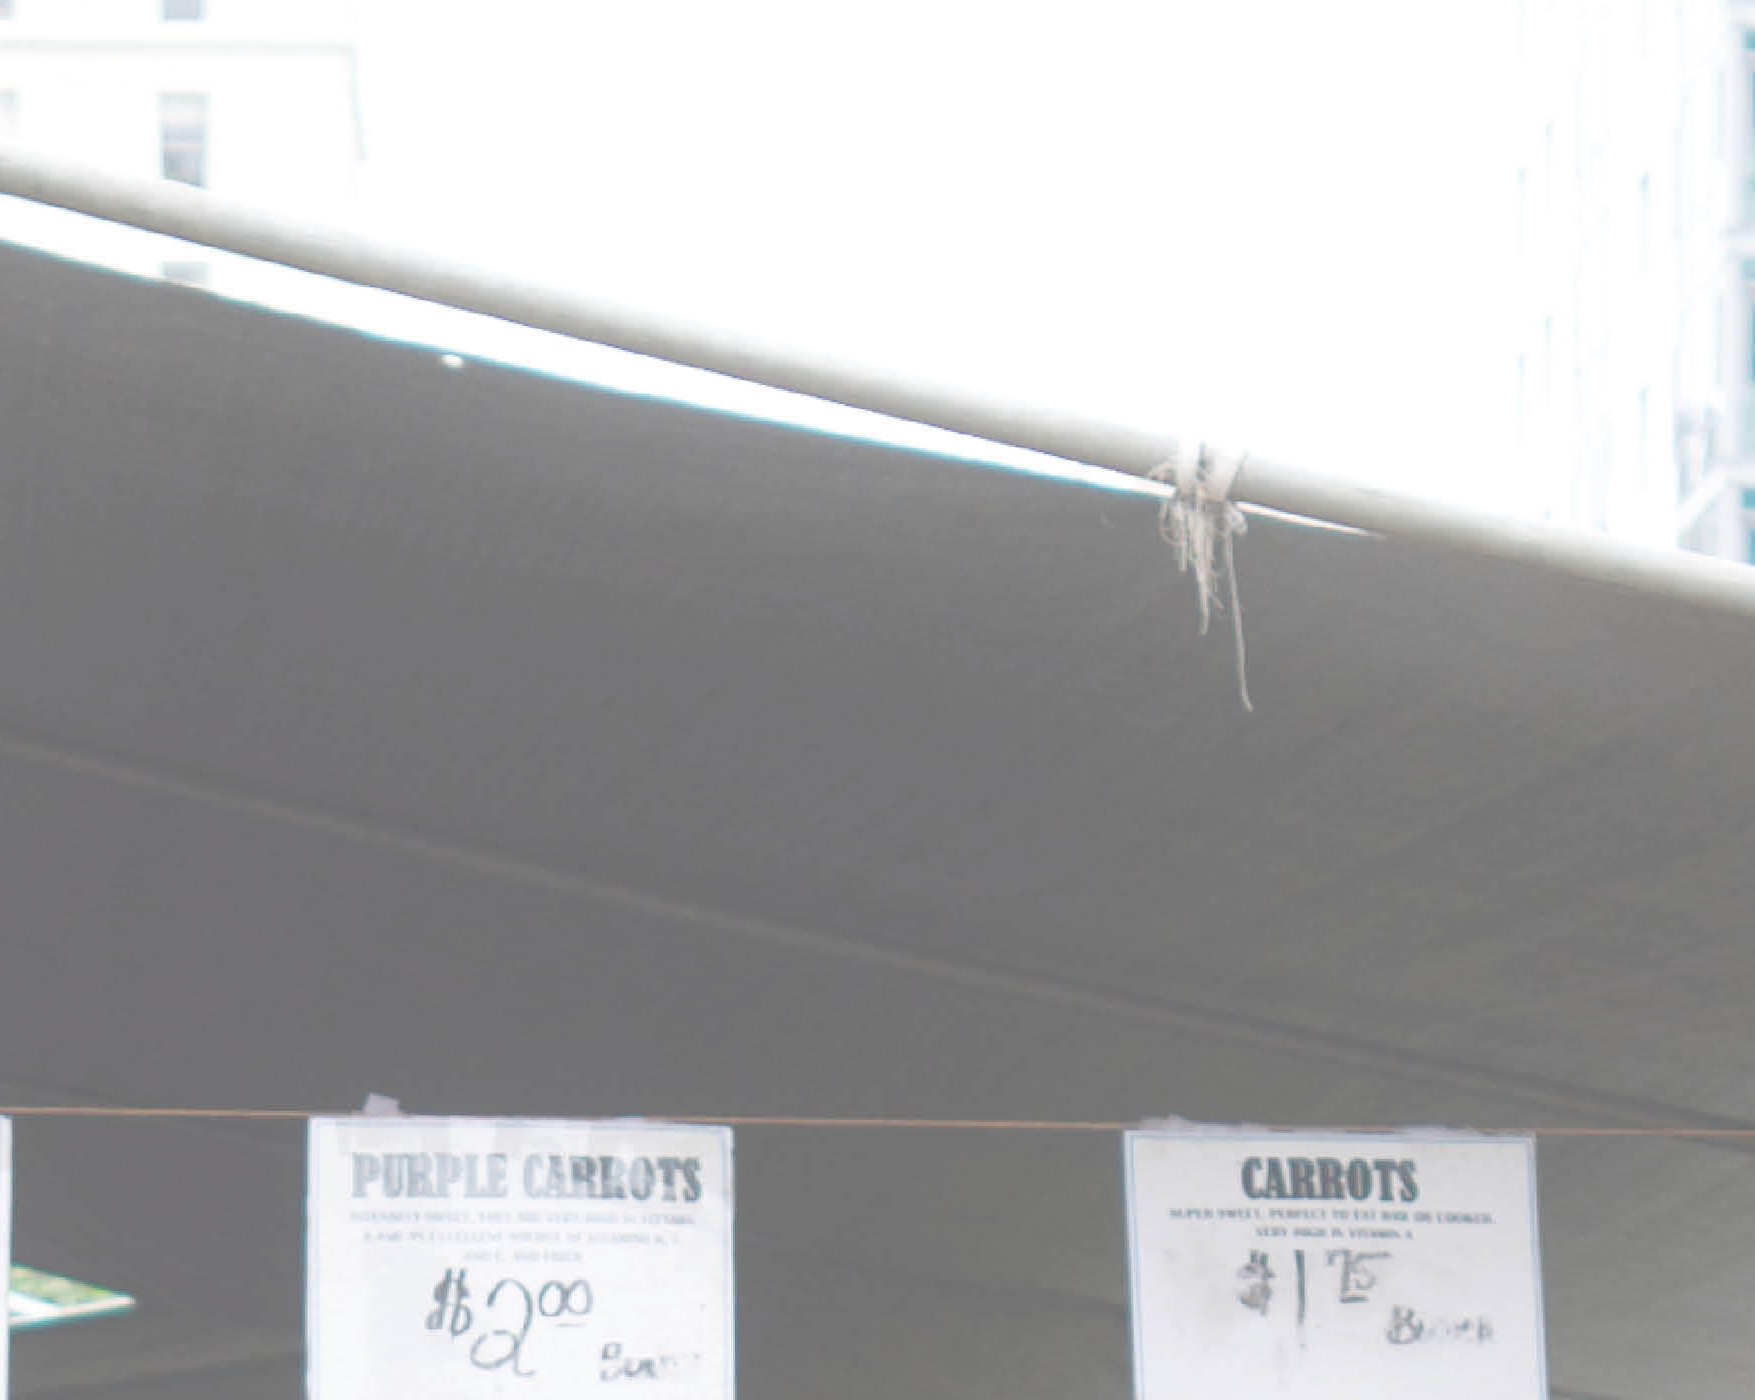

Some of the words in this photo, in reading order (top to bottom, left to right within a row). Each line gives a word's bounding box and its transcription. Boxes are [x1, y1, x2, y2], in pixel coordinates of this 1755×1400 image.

[351, 1152, 508, 1199] PURPLE
[523, 1154, 702, 1203] CARROTS
[1241, 1156, 1419, 1203] CARROTS
